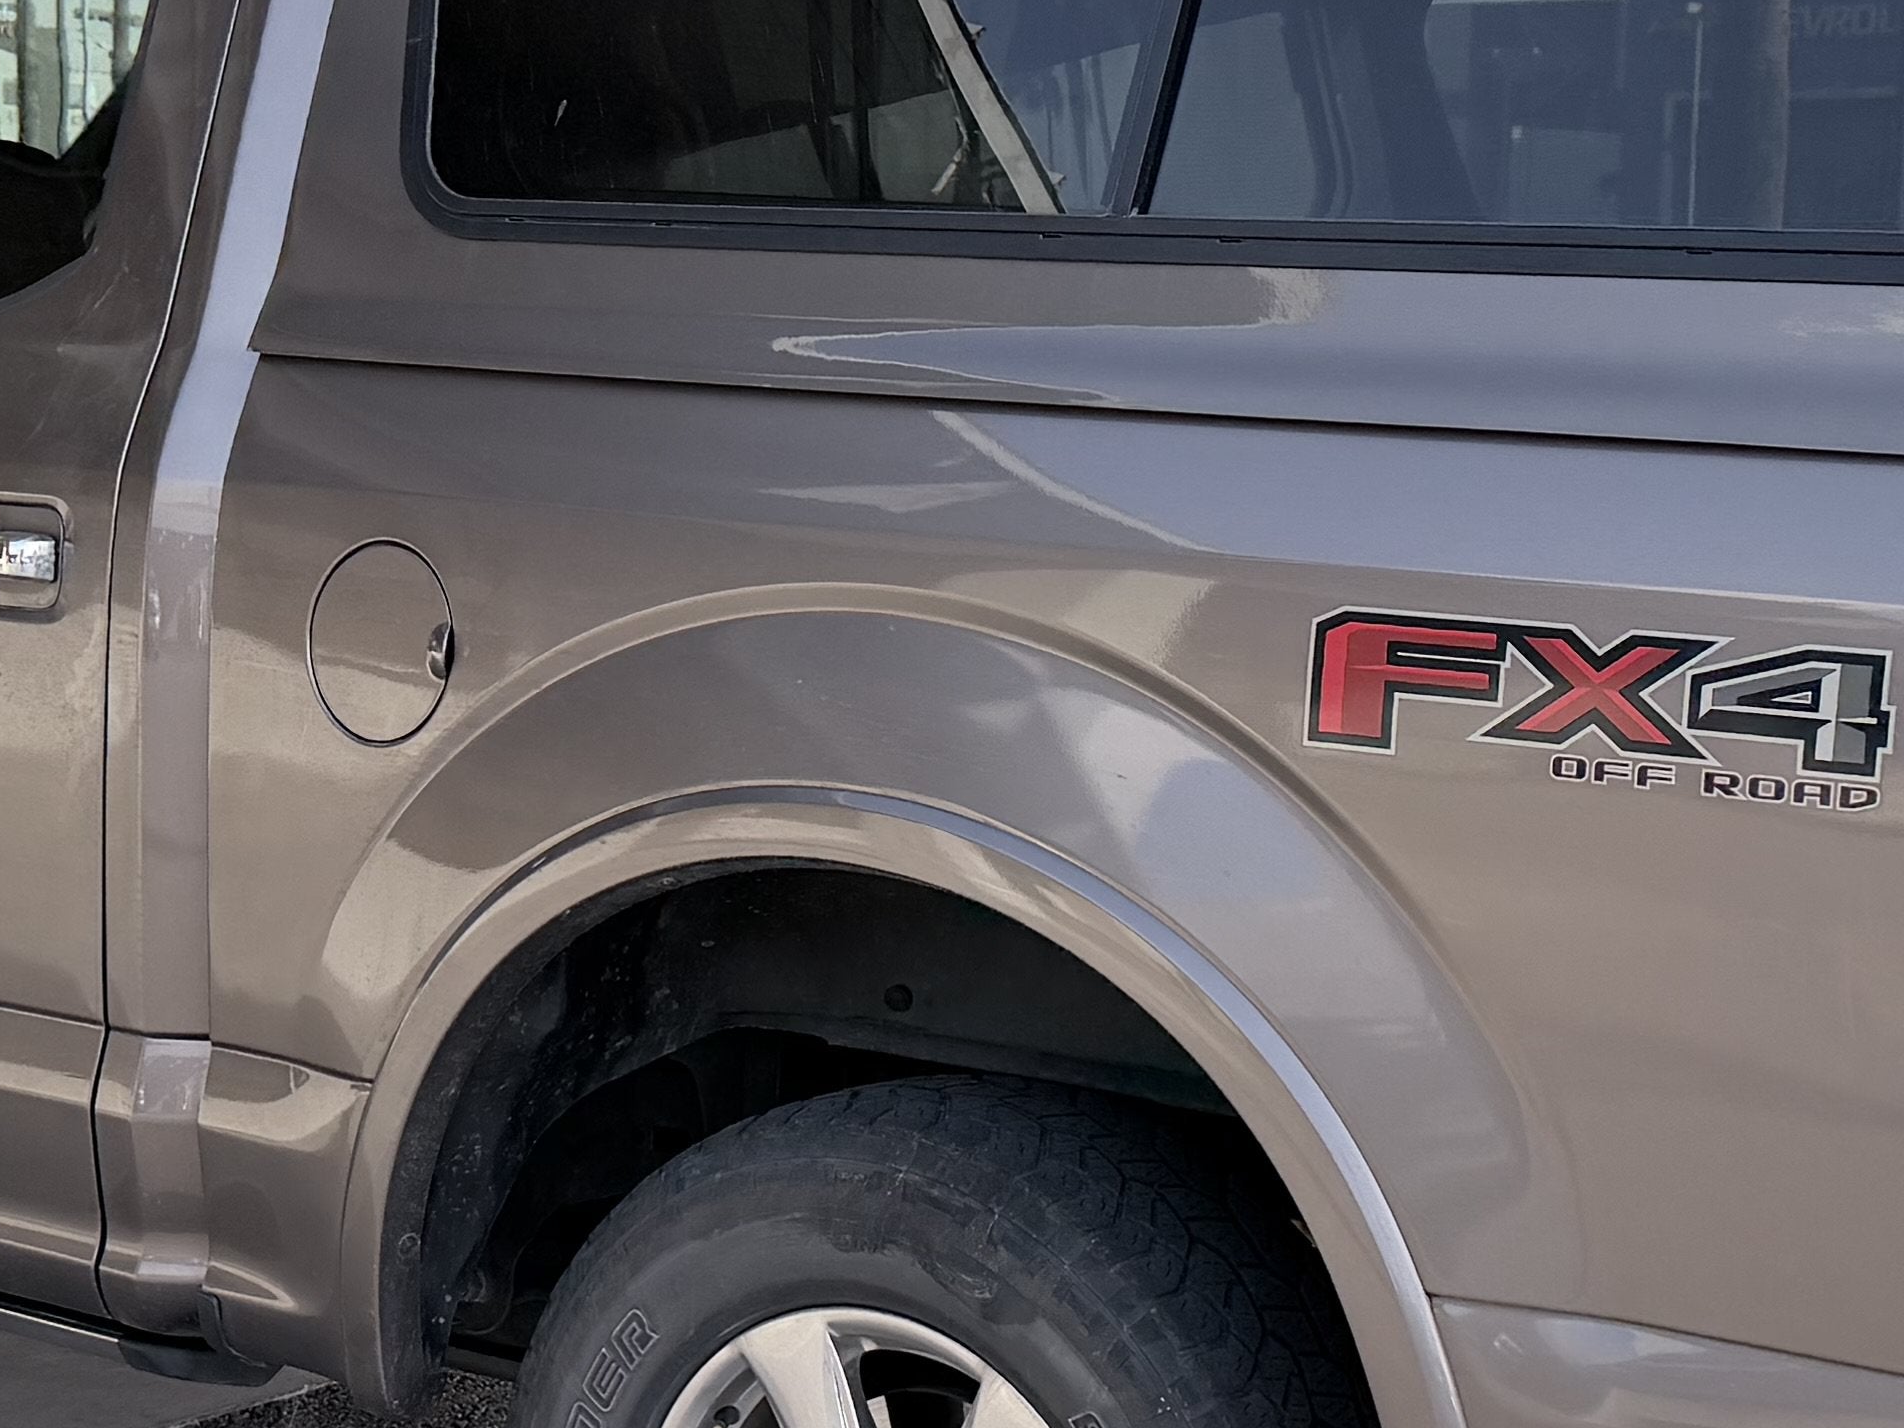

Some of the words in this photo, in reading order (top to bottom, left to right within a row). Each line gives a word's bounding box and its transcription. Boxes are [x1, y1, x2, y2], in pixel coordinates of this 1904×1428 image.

[1303, 605, 1896, 783] FX4
[1549, 754, 1677, 790] OFF
[1700, 771, 1882, 812] ROAD
